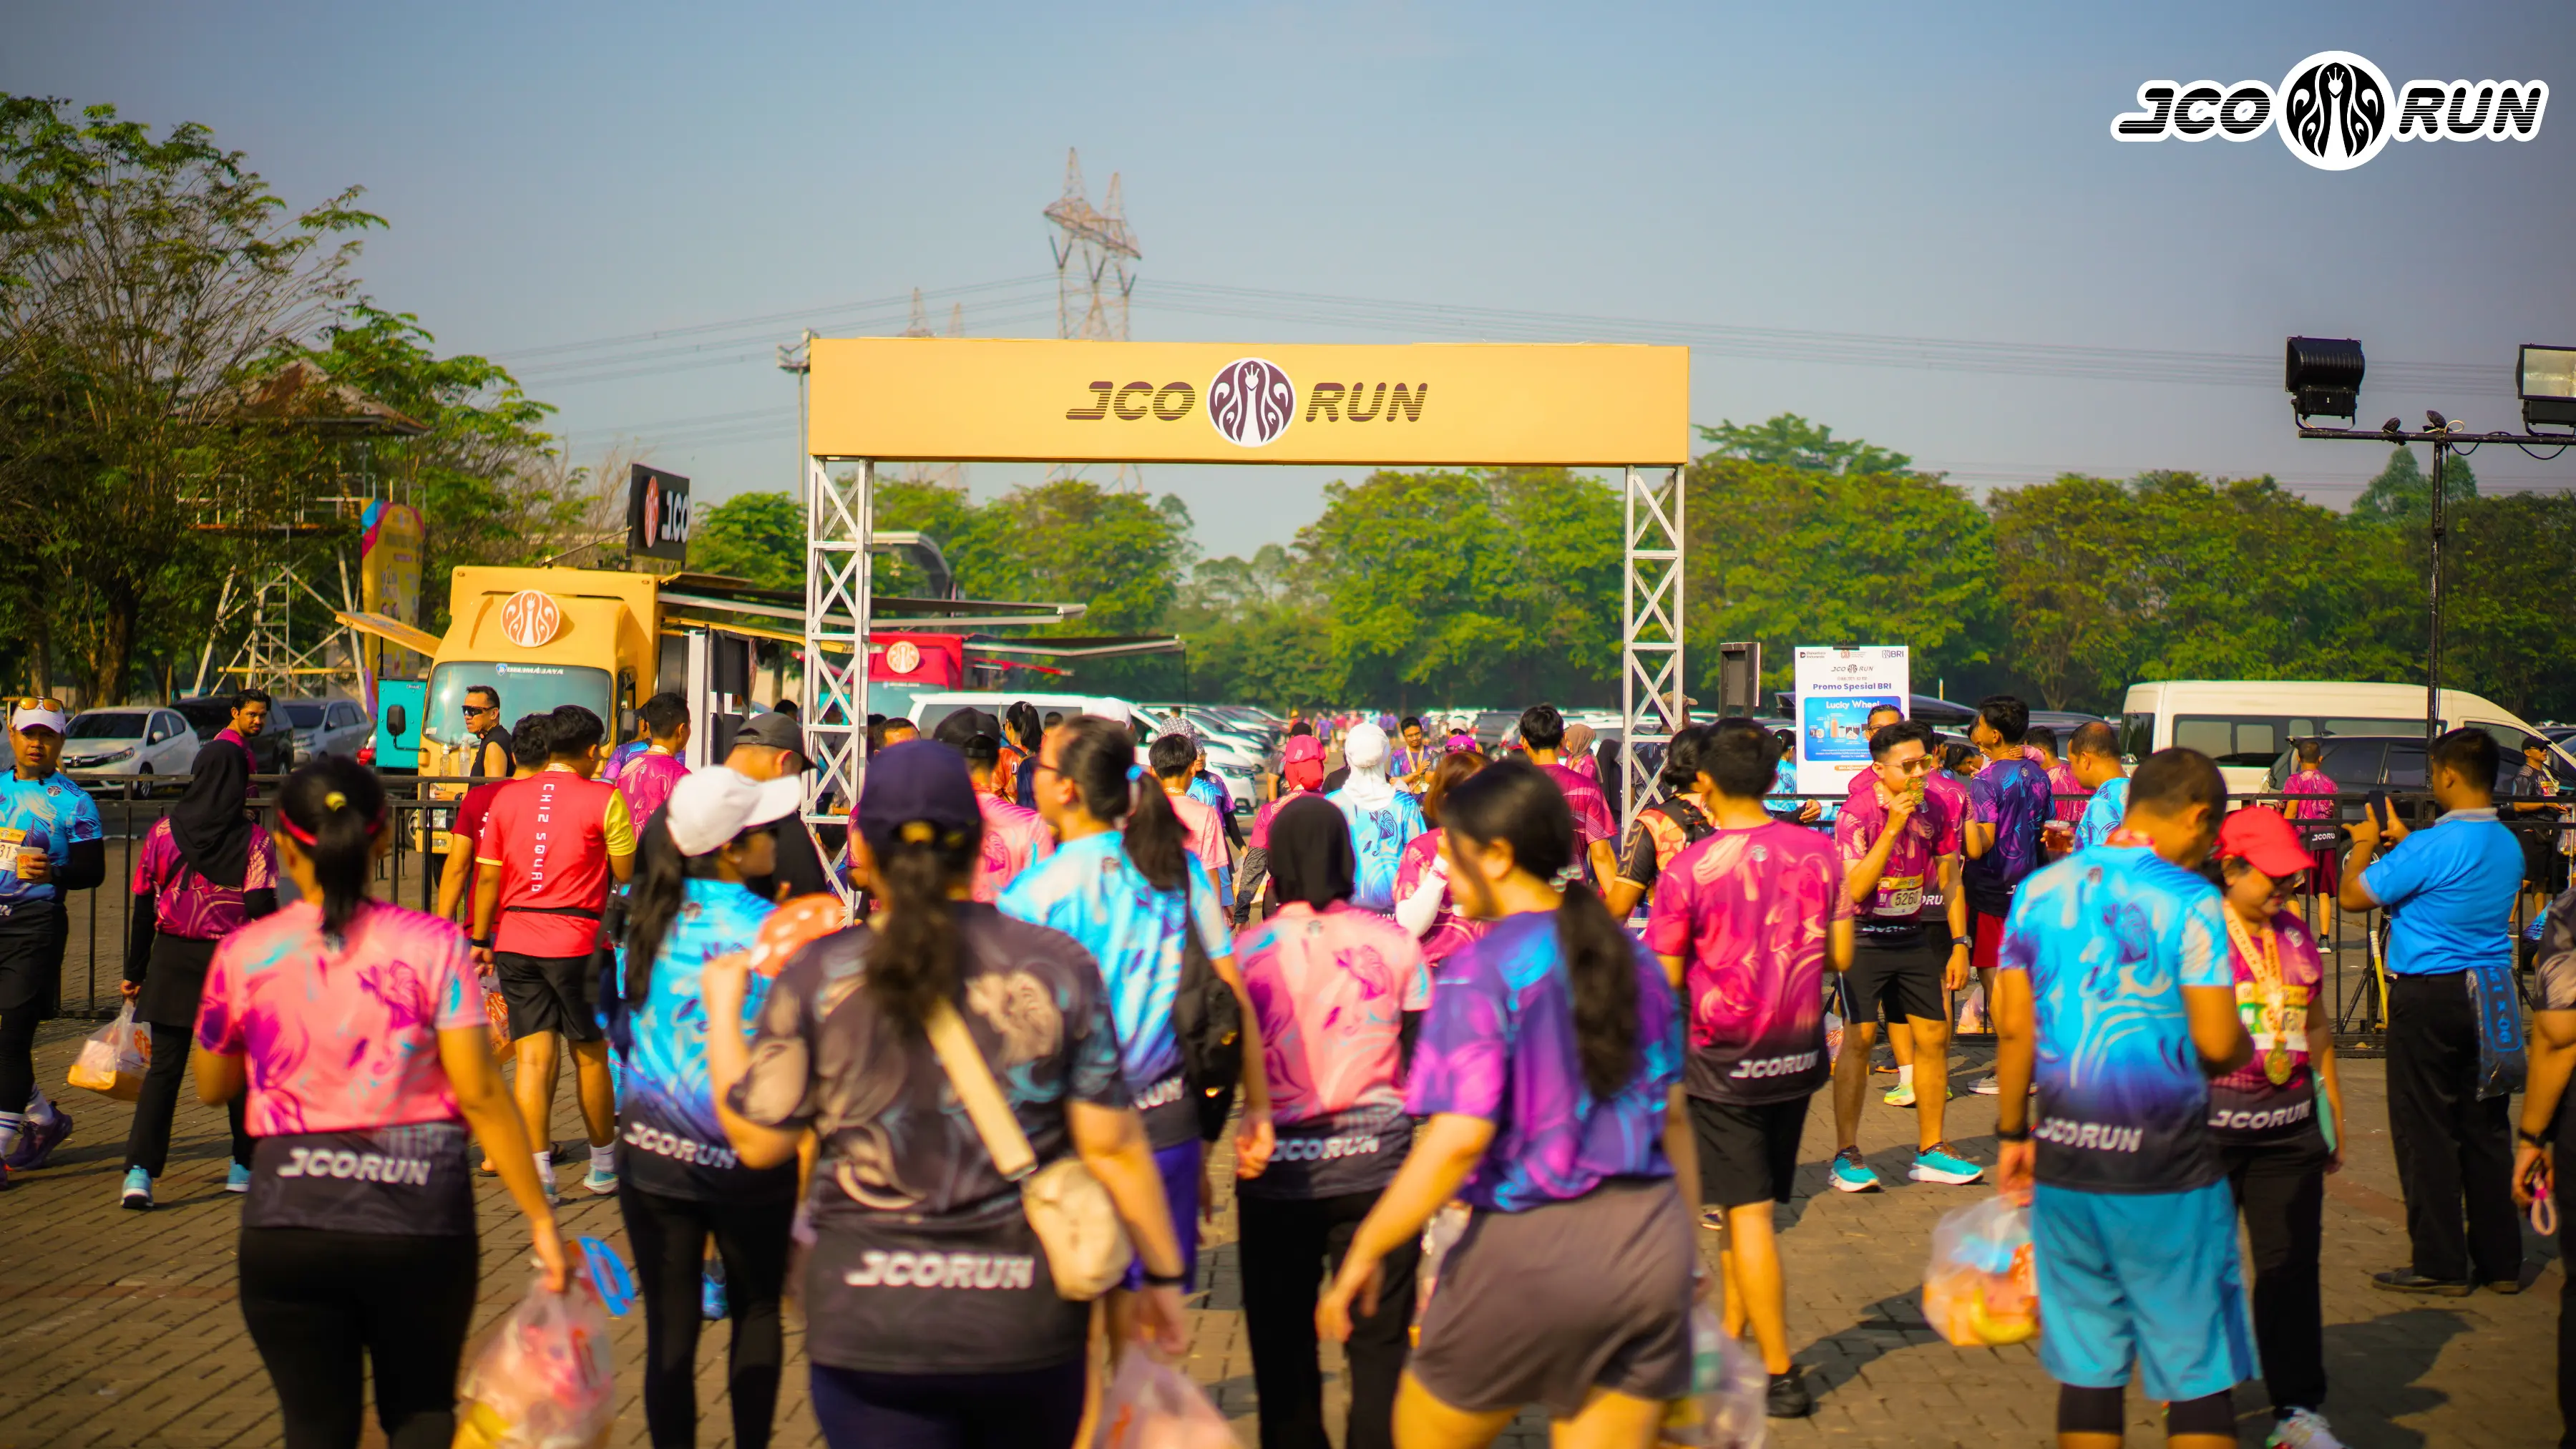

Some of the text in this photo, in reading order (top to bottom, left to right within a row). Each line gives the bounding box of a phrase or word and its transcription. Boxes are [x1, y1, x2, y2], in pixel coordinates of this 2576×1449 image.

[1065, 381, 1428, 423] JCO RUN
[1826, 701, 1850, 710] Lucky
[1844, 683, 1875, 692] Spesial
[2207, 1099, 2311, 1128] JCORUN
[623, 1121, 738, 1169] JCORUN
[2036, 1117, 2143, 1153] JCORUN
[276, 1147, 431, 1186] JCORUN
[844, 1250, 1035, 1289] JCORUN
